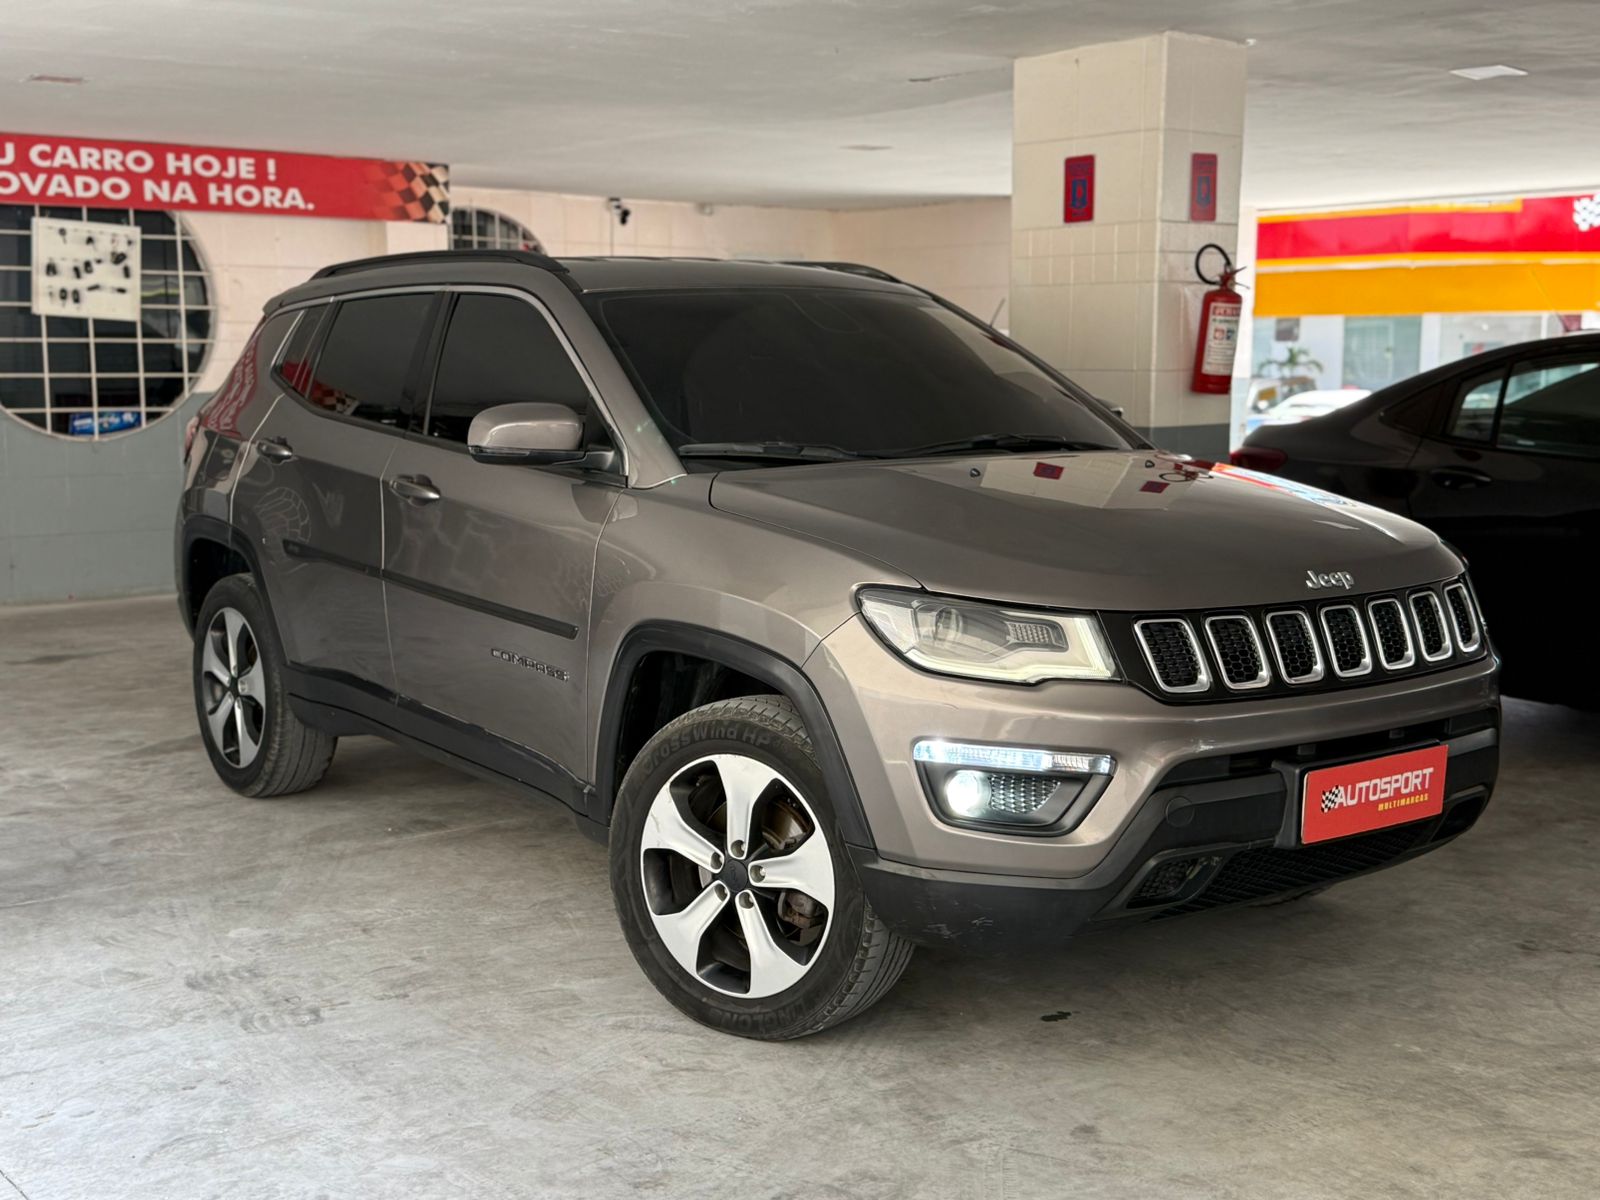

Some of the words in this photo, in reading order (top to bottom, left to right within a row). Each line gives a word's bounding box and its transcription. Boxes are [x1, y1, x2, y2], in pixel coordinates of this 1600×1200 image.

[28, 143, 155, 174] CARRO
[166, 152, 256, 180] HOJE
[266, 158, 277, 182] !
[0, 170, 132, 201] OVADO
[143, 179, 198, 204] NA
[208, 182, 315, 210] HORA.
[1305, 570, 1354, 590] Jeep
[491, 648, 569, 682] COMPASS
[1333, 766, 1435, 809] AUTOSPORT
[1378, 793, 1429, 812] MULTIMARCAS
